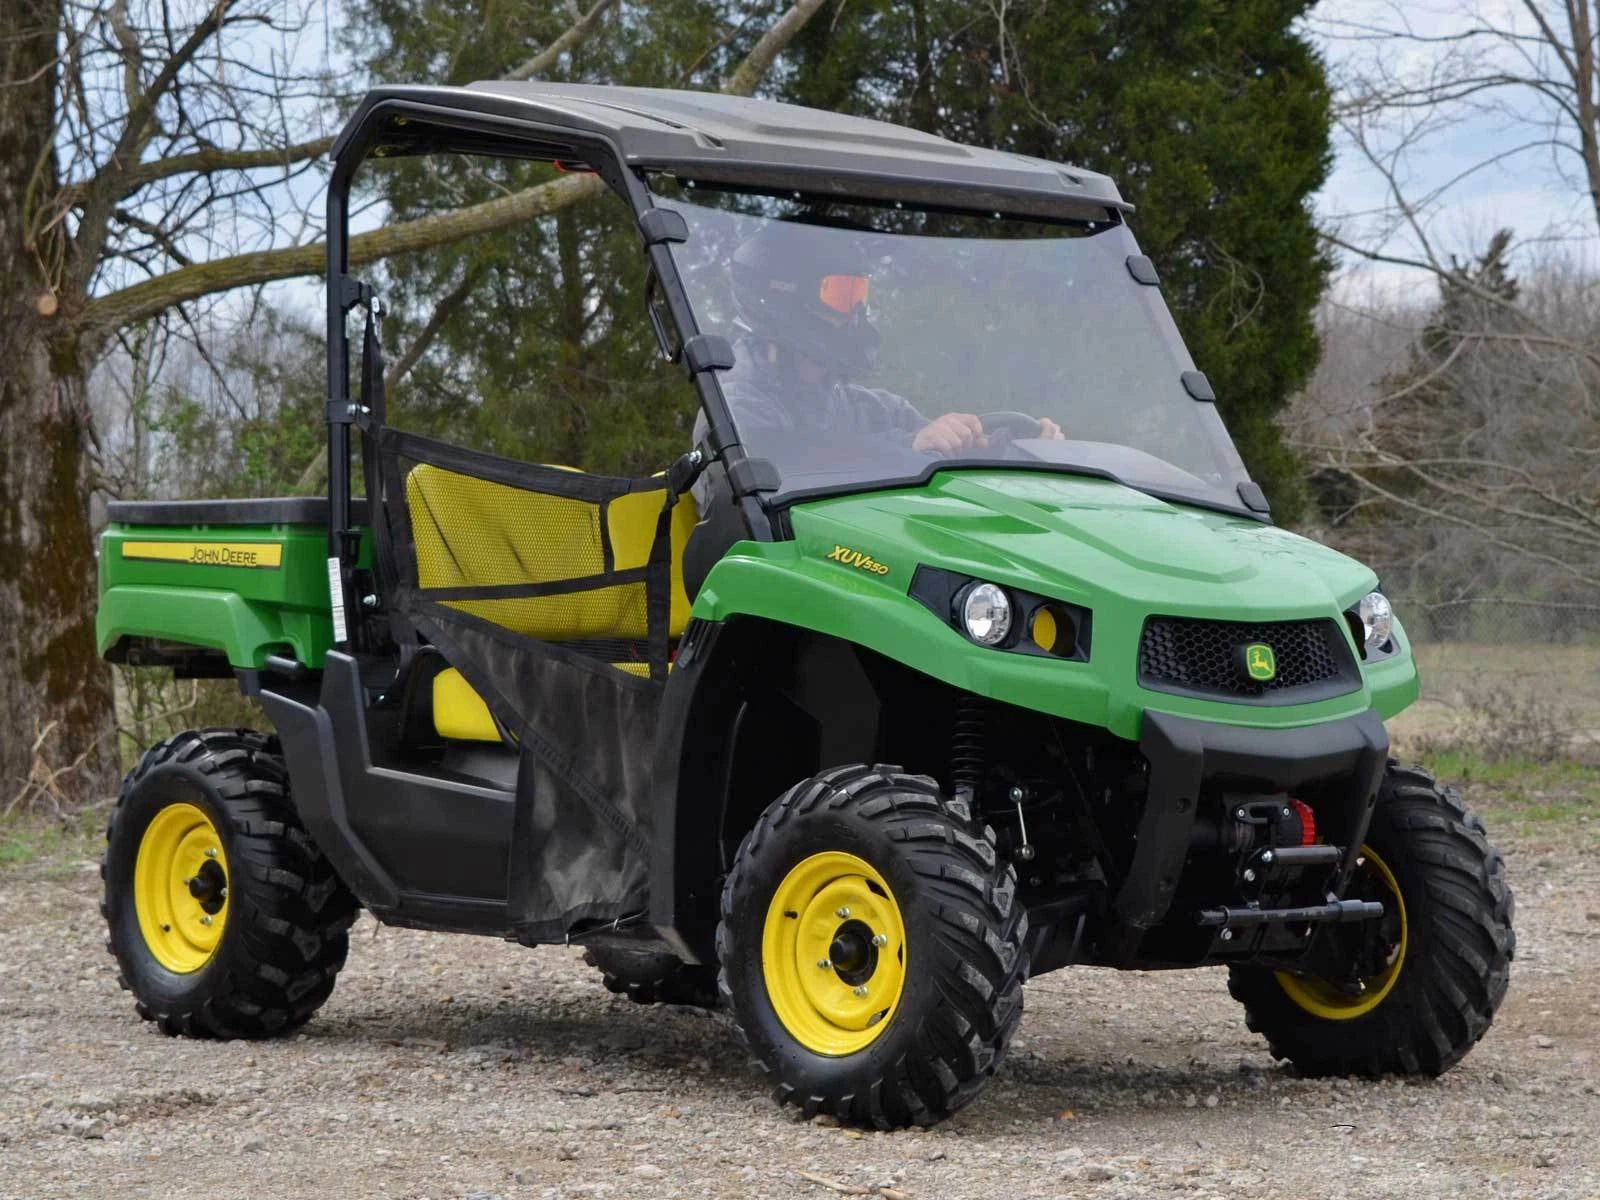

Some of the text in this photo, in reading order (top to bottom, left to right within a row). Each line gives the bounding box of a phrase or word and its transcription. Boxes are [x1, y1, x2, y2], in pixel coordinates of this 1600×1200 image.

[189, 545, 257, 565] JOHN DEERE
[826, 544, 889, 575] XUV550
